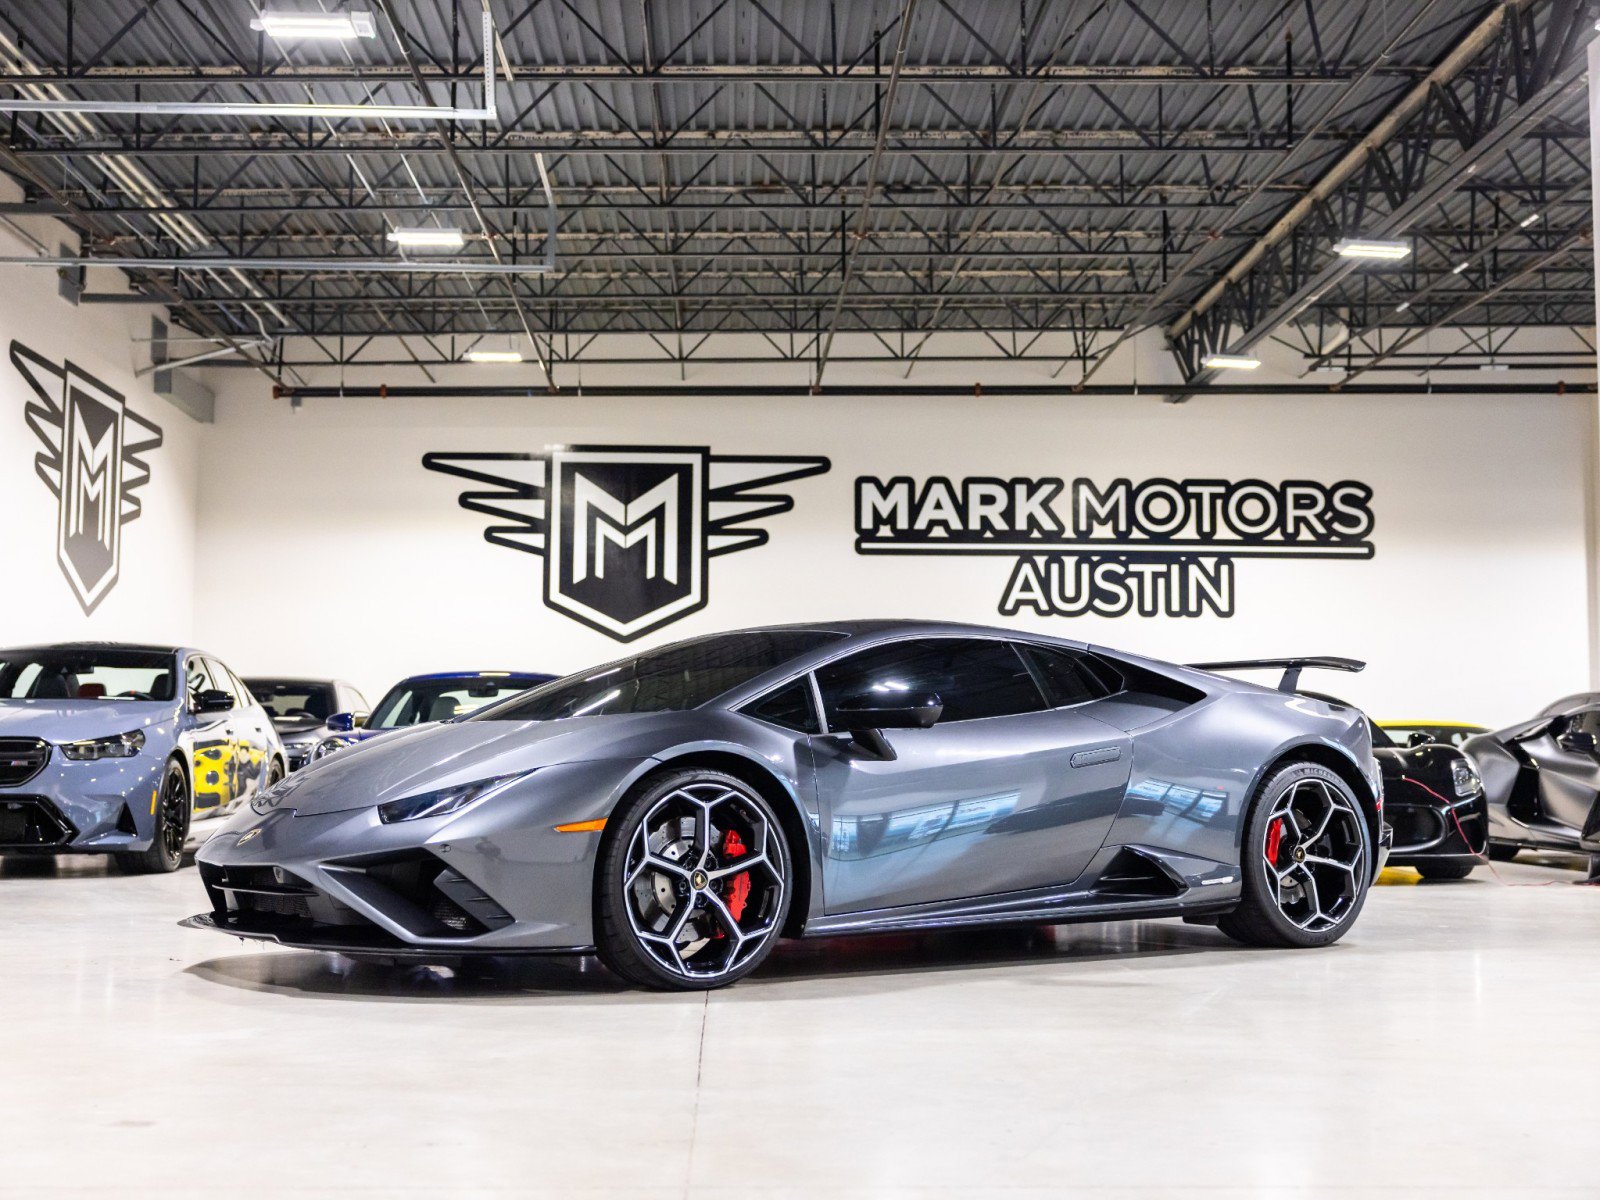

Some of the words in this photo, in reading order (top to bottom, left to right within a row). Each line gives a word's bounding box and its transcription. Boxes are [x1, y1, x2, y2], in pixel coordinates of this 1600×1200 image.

[859, 480, 1060, 532] MARK
[1077, 484, 1371, 536] MOTORS
[1003, 560, 1231, 613] AUSTIN
